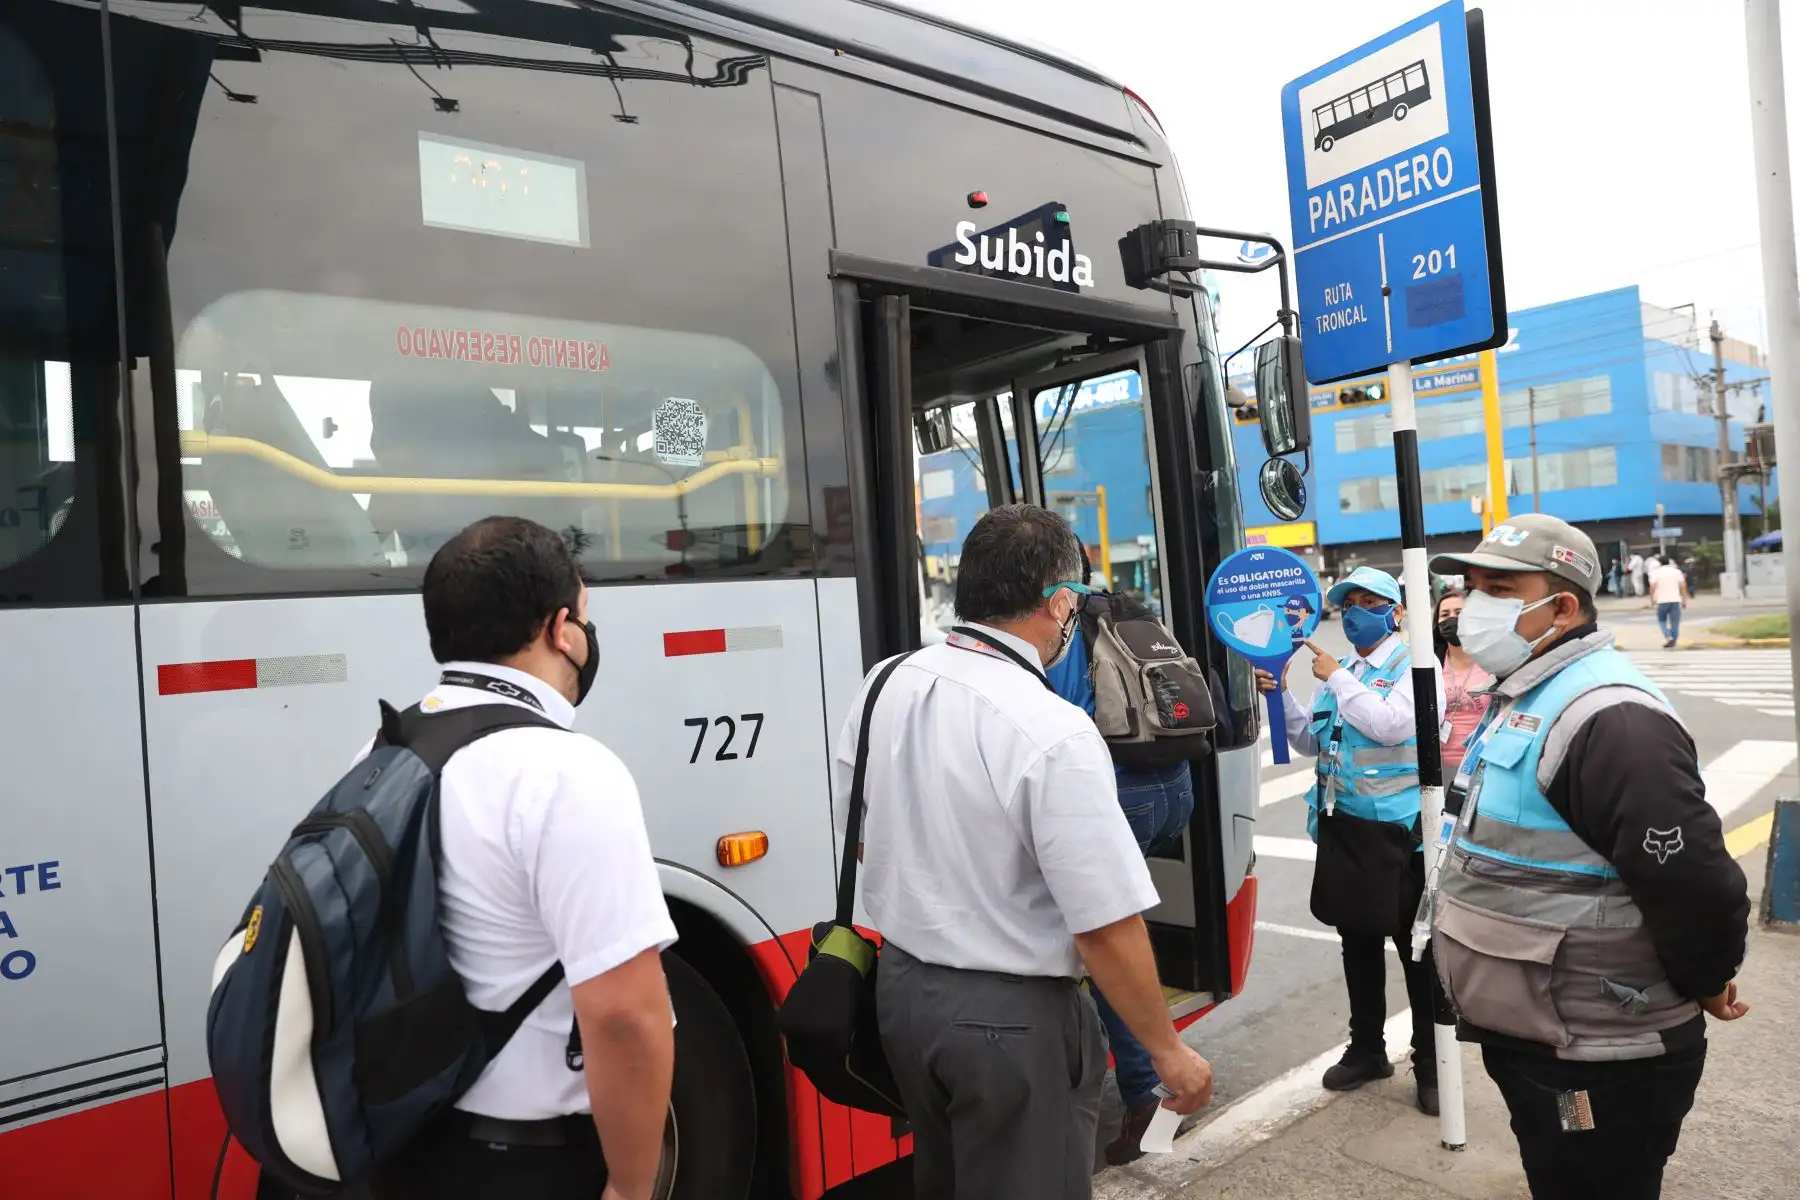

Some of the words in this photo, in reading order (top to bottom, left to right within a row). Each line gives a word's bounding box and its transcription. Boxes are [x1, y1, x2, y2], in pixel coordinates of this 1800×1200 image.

[1308, 146, 1453, 234] PARADERO
[954, 220, 1095, 288] Subida
[1412, 243, 1457, 281] 201
[1324, 282, 1353, 307] RUTA
[1316, 304, 1368, 335] TRONCAL
[1415, 378, 1432, 391] La
[1433, 371, 1475, 388] Marina
[1217, 576, 1229, 586] Es
[1230, 567, 1303, 584] OBLIGATORIO
[1217, 587, 1224, 595] el
[1225, 586, 1238, 594] uso
[1249, 582, 1269, 591] doble
[1270, 578, 1306, 589] mascarilla
[1247, 592, 1261, 600] una
[684, 712, 764, 764] 727
